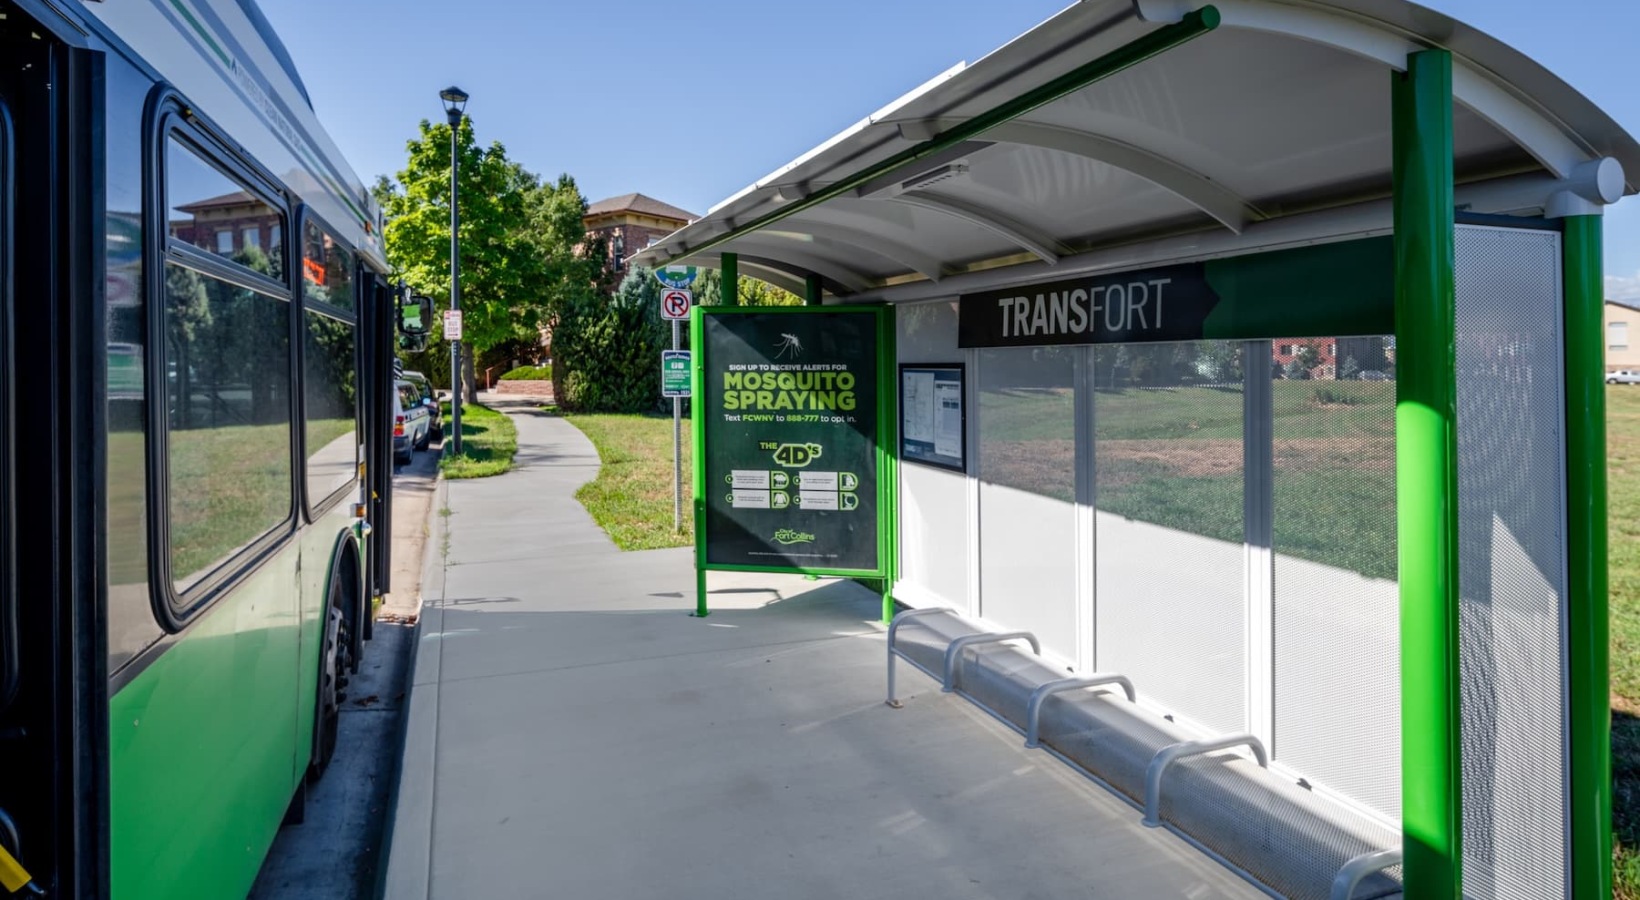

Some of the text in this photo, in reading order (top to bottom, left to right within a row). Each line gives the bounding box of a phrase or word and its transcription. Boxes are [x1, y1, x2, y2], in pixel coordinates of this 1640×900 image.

[677, 278, 690, 287] STOP
[998, 278, 1171, 338] TRANSFORT
[723, 372, 855, 390] MOSQUITO
[723, 390, 856, 410] SPRAYING
[724, 414, 741, 422] Text
[742, 414, 775, 422] FCWNV
[776, 414, 785, 422] to
[786, 414, 820, 422] 888-777
[820, 415, 830, 423] to
[831, 415, 846, 425] opt
[760, 442, 777, 450] THE
[774, 531, 815, 540] Fort Collins
